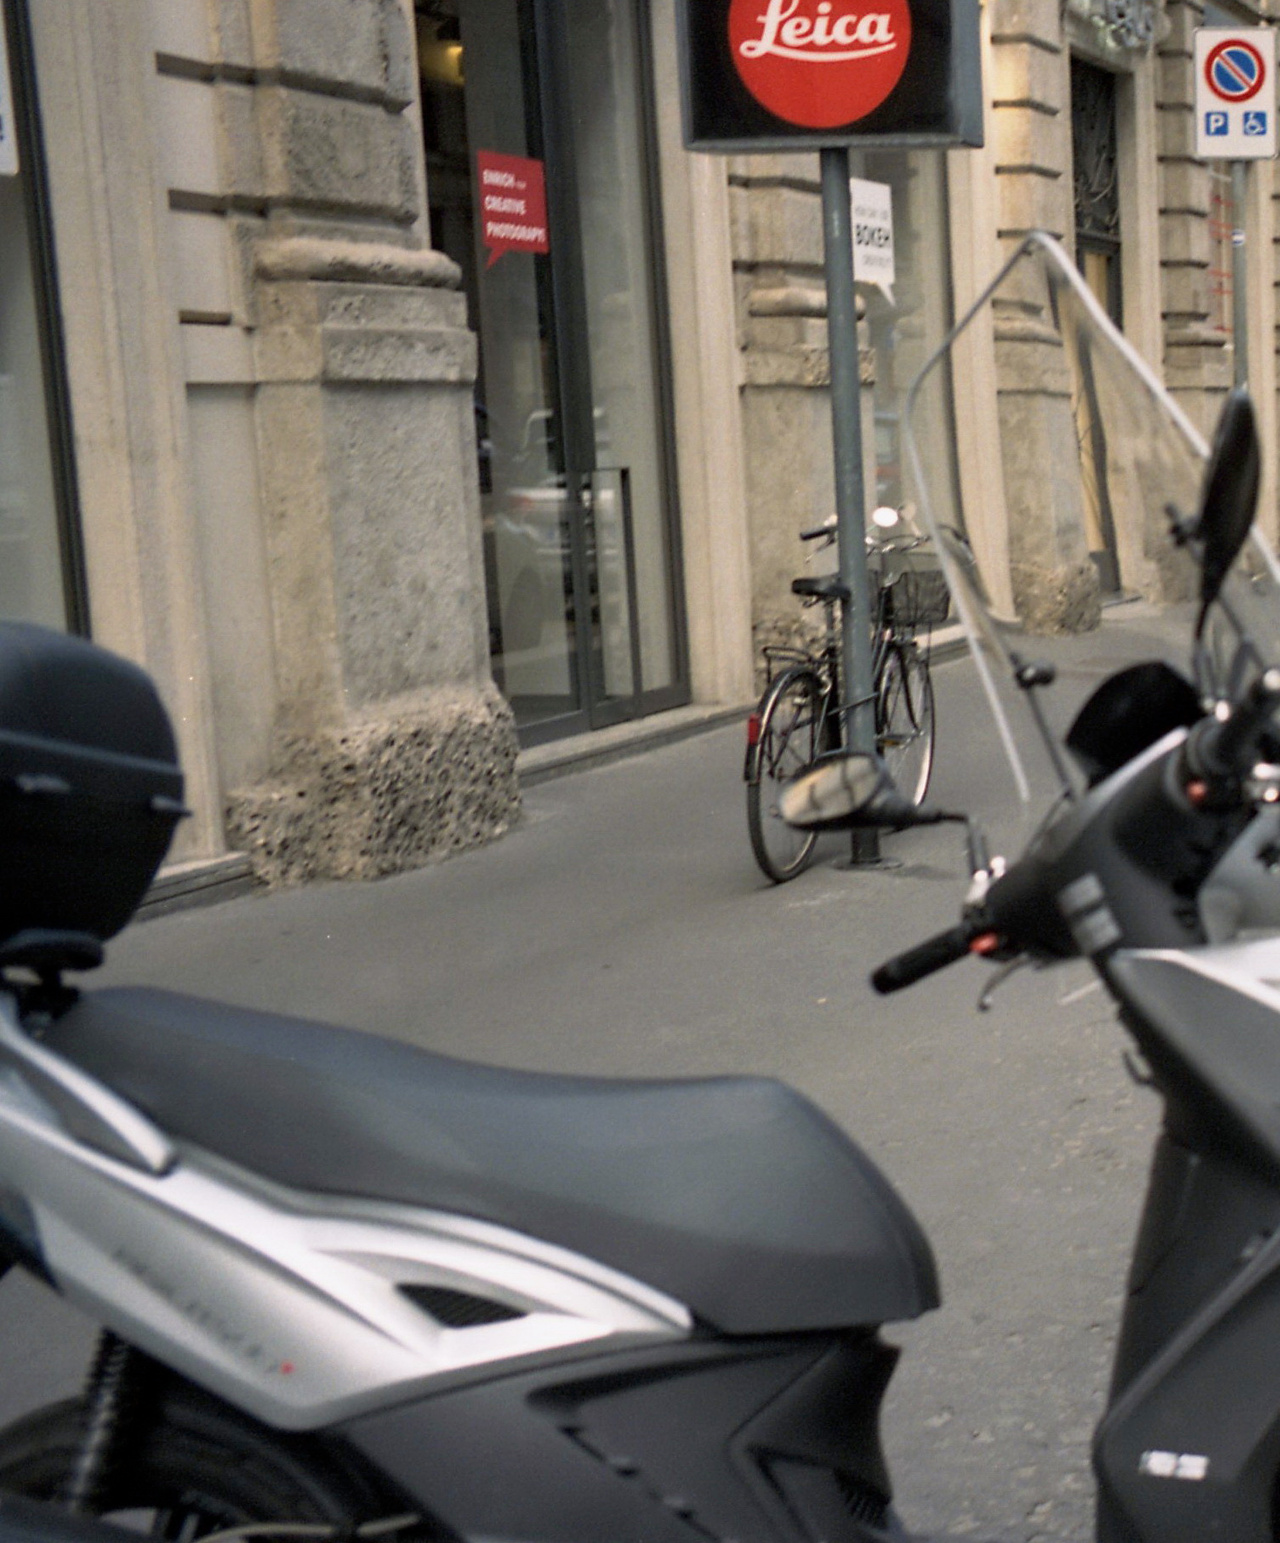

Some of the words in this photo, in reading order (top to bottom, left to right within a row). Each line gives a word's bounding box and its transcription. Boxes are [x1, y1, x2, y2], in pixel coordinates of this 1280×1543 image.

[739, 0, 897, 62] Leica
[1210, 114, 1225, 134] P
[482, 168, 515, 189] ENRICH
[484, 194, 527, 216] CREATIVE
[856, 223, 891, 248] BOKEH
